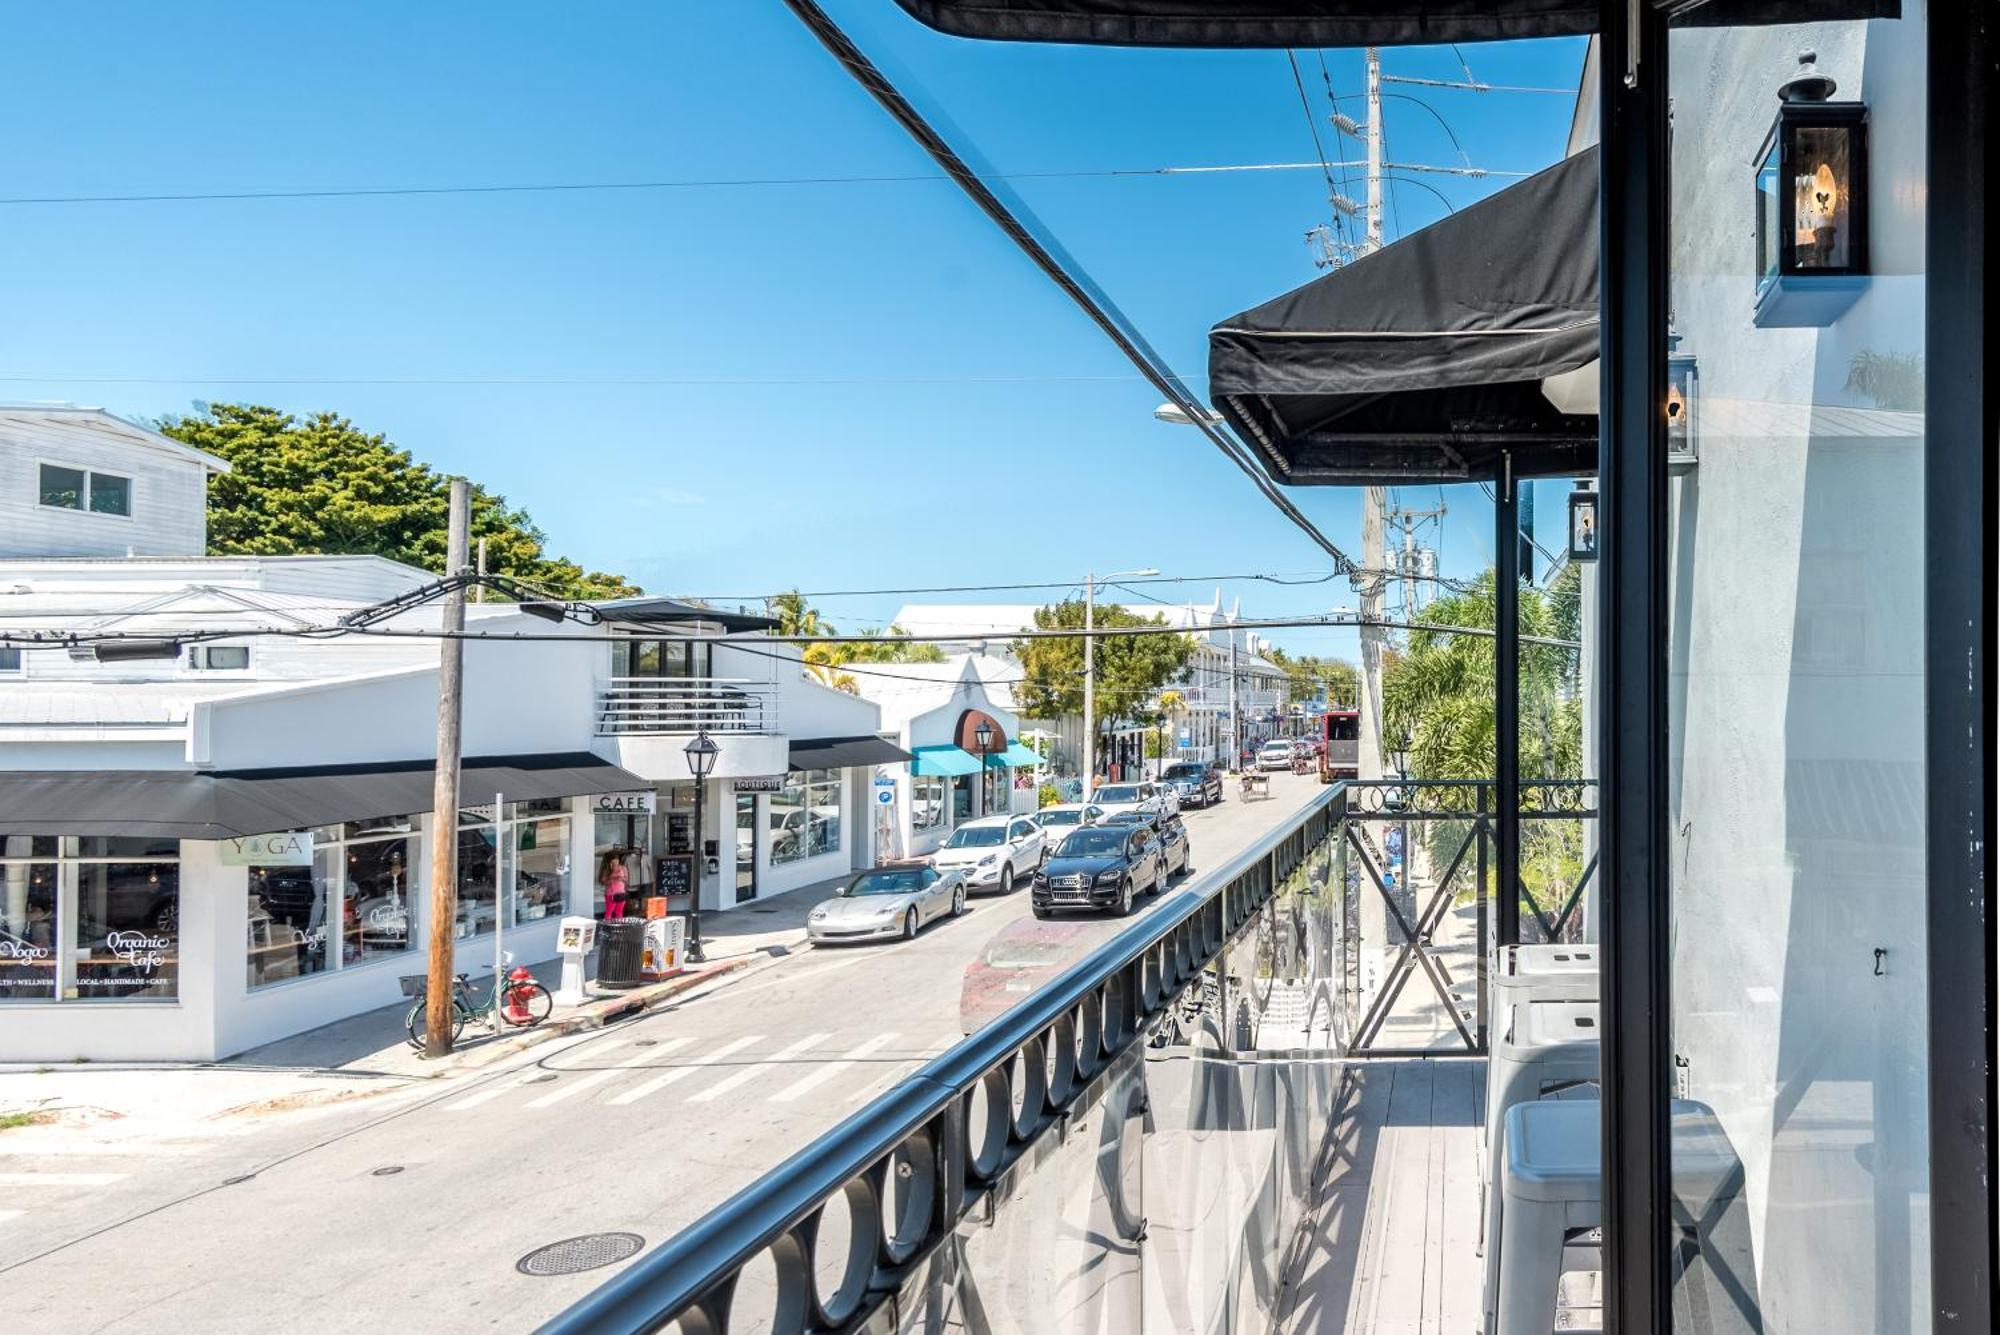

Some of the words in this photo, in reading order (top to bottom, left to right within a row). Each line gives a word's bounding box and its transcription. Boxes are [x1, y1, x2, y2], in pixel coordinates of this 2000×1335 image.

[734, 780, 781, 790] BOUTIQUE
[599, 796, 645, 809] CAFE
[107, 930, 170, 953] Organic
[0, 941, 49, 966] Yoga
[117, 950, 166, 974] Cafe
